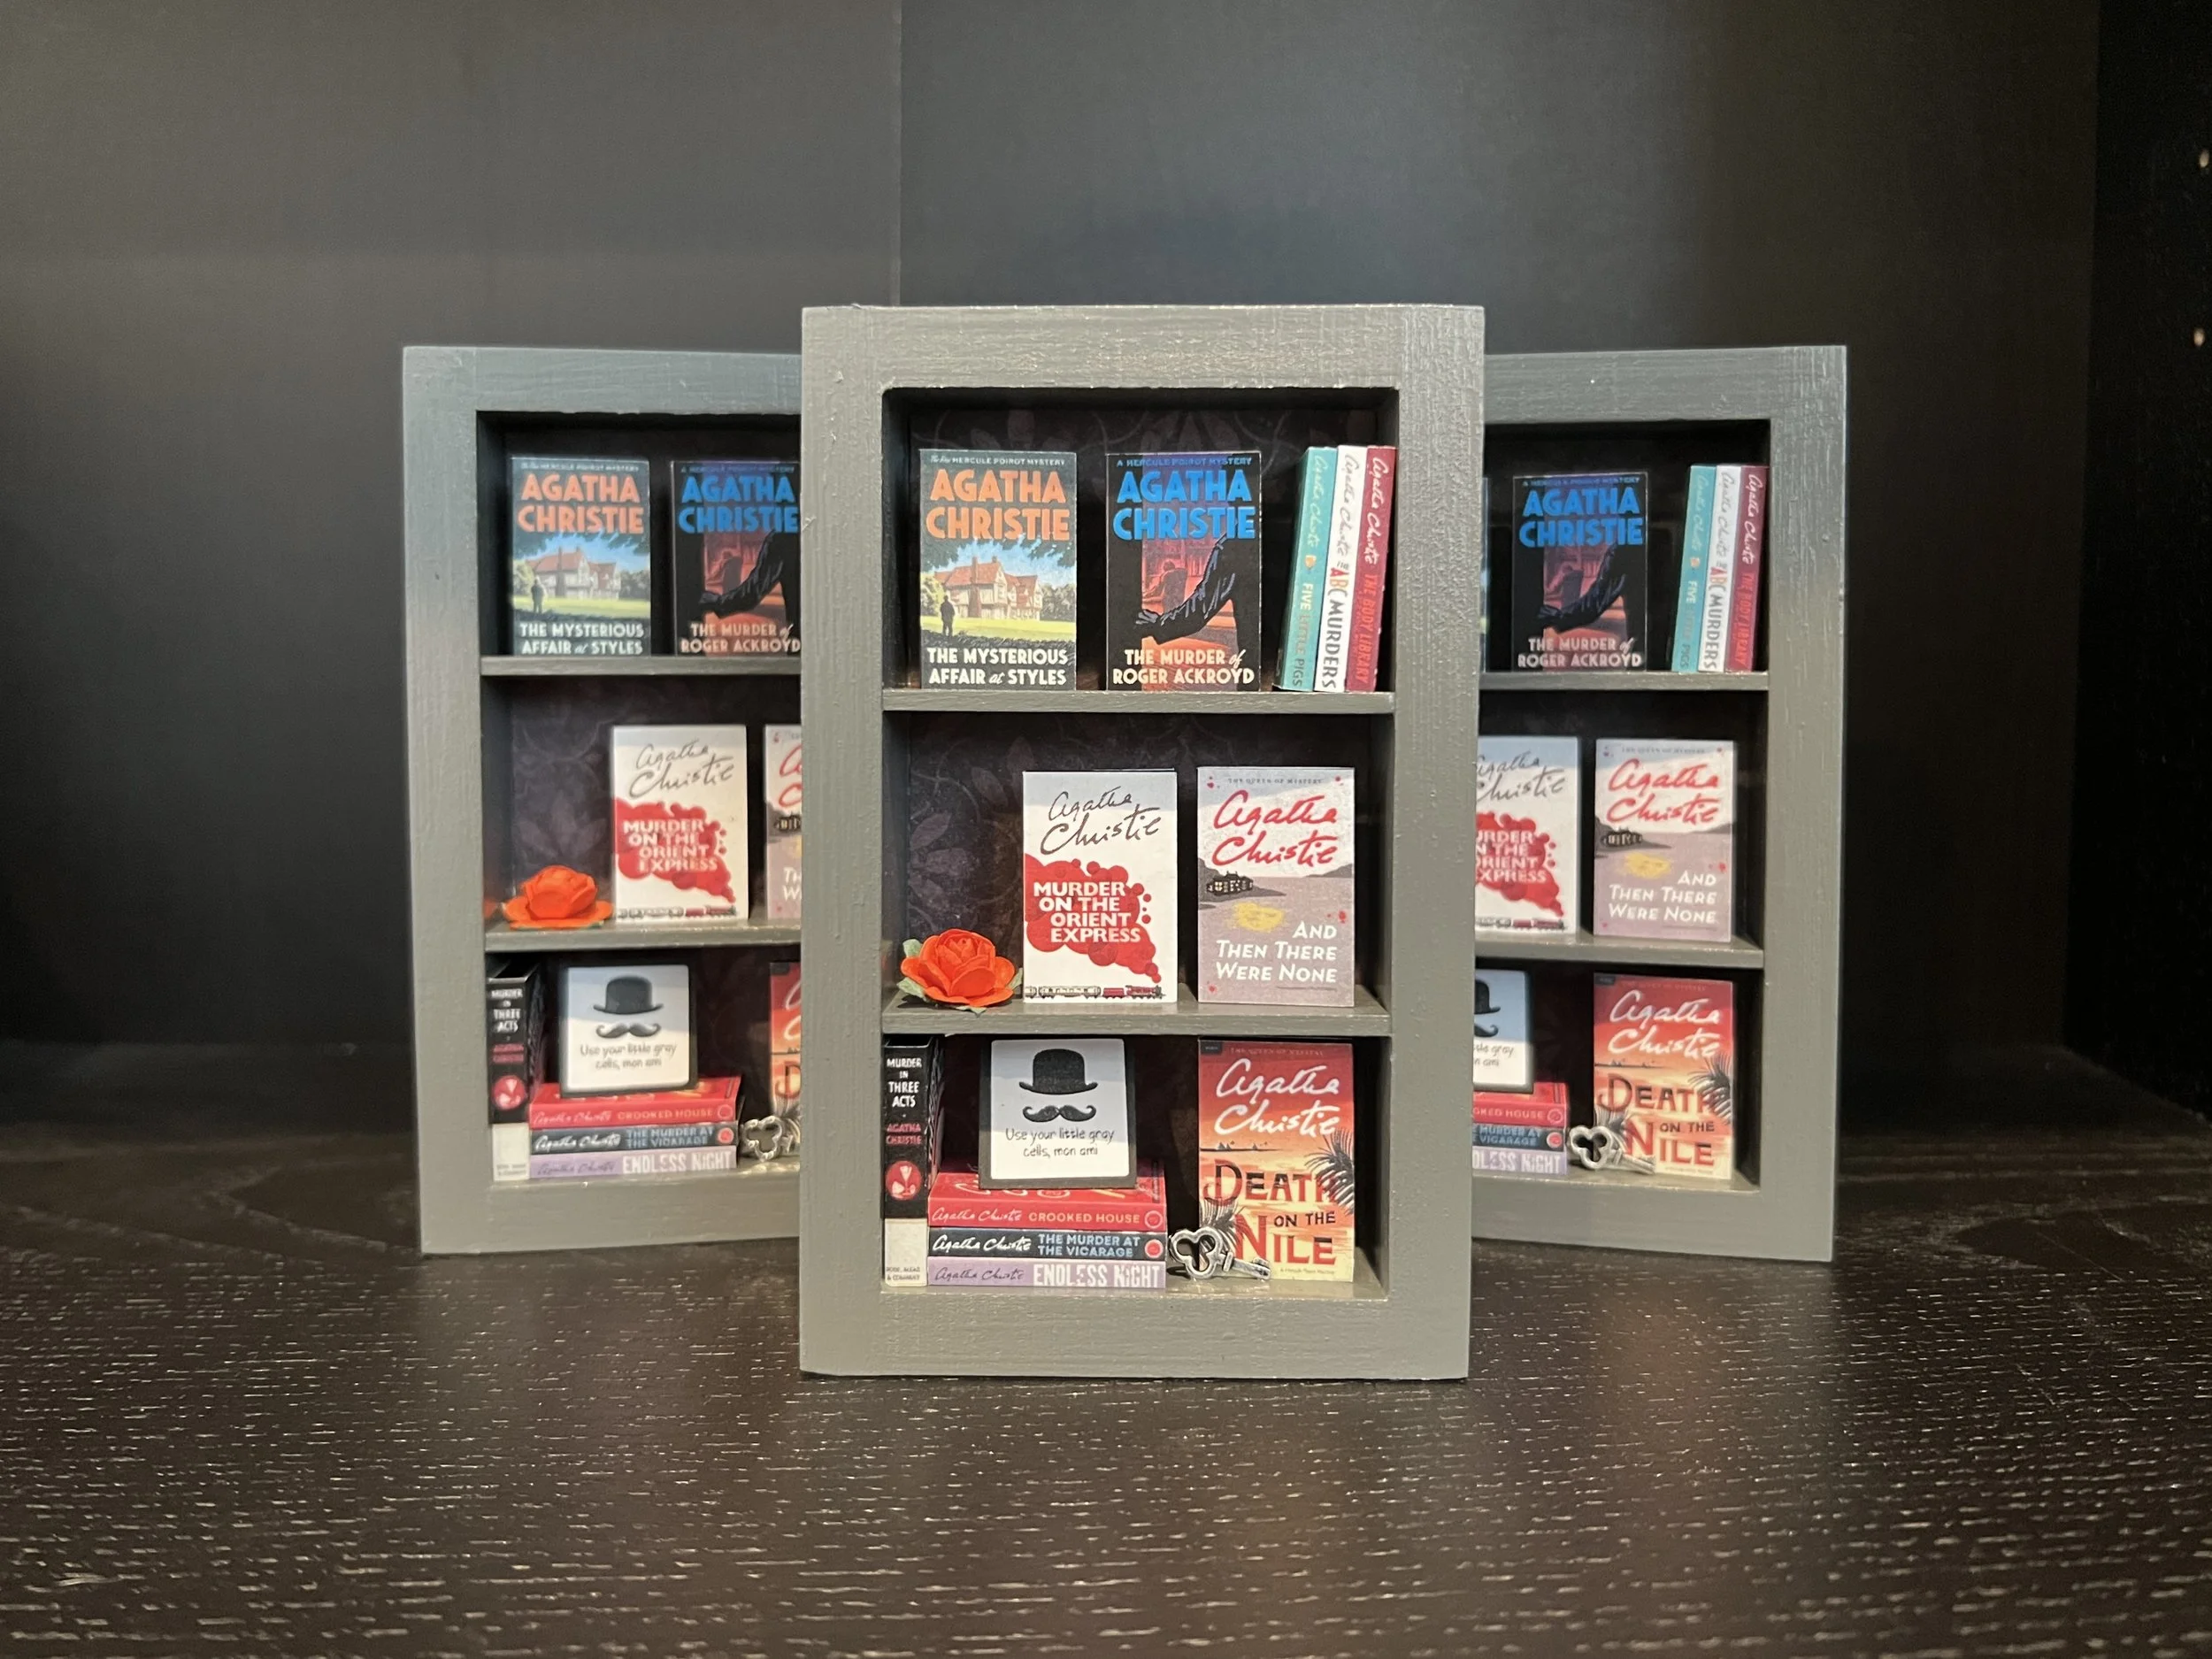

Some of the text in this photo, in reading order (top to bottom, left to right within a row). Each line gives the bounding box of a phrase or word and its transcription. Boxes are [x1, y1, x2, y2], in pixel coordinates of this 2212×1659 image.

[1027, 457, 1065, 466] MYSTERY
[521, 472, 641, 503] AGATHA
[681, 476, 795, 503] AGATHA
[930, 468, 1066, 503] AGATHA
[1117, 469, 1252, 503] AGATHA
[1369, 457, 1389, 509] Agatha
[1523, 487, 1640, 517] AGATHA
[518, 505, 644, 534] CHRISTIE
[679, 506, 799, 533] CHRISTIE
[926, 506, 1070, 541] CHRISTIE
[1112, 506, 1256, 541] CHRISTIE
[1363, 512, 1382, 565] Christie
[1519, 518, 1643, 548] CHRISTIE
[1327, 567, 1349, 597] ABC
[520, 622, 644, 639] THE MYSTERIOUS
[690, 623, 777, 637] THE MURDER
[1293, 582, 1314, 687] FIVE PIGS
[1703, 594, 1724, 669] MURDERS
[522, 640, 642, 655] AFFAIR at STYLES
[680, 638, 801, 653] ROGER ACKROYD
[1321, 599, 1346, 688] MURDERS
[1528, 637, 1554, 651] THE
[1559, 637, 1616, 651] MURDER
[927, 648, 1069, 665] THE MYSTERIOUS
[1125, 649, 1247, 669] THE MURDER of
[1517, 653, 1642, 667] ROGER ACKROYD
[929, 668, 1067, 685] AFFAIR at STYLES
[1113, 667, 1255, 685] ROGER ACKROYD
[635, 738, 708, 771] Agatha
[629, 754, 734, 798] Christie
[1608, 758, 1719, 796] Agatha
[1048, 786, 1133, 822] Agatha
[1213, 789, 1338, 835] Agatha
[1607, 794, 1720, 825] Christie
[623, 818, 704, 833] MURDER
[1040, 804, 1162, 856] Christie
[628, 832, 700, 847] ON THE
[1212, 830, 1338, 867] Christie
[1492, 842, 1529, 856] THE
[638, 845, 710, 859] ORIENT
[638, 858, 718, 872] EXPRESS
[1678, 871, 1717, 885] AND
[1033, 881, 1126, 897] MURDER
[1609, 884, 1717, 904] THEN THERE
[1039, 897, 1120, 912] ON THE
[1609, 903, 1718, 924] WERE NONE
[1050, 912, 1132, 927] ORIENT
[1050, 928, 1141, 943] EXPRESS
[1292, 920, 1338, 940] AND
[1216, 940, 1338, 961] THEN THERE
[1216, 962, 1338, 983] WERE NONE
[1609, 989, 1722, 1029] Agatha
[496, 1020, 518, 1033] ACTS
[580, 1044, 601, 1056] Use
[603, 1046, 625, 1057] your
[1607, 1025, 1721, 1059] Christie
[887, 1058, 922, 1068] MURDER
[888, 1081, 920, 1094] THREE
[1216, 1057, 1340, 1105] Agatha
[892, 1095, 916, 1108] ACTS
[1597, 1072, 1717, 1113] DEATH
[617, 1111, 672, 1121] CROOKED
[677, 1109, 713, 1118] HOUSE
[1214, 1099, 1340, 1138] Christie
[1506, 1110, 1544, 1119] HOUSE
[626, 1128, 648, 1139] THE
[651, 1127, 696, 1137] MURDER
[699, 1126, 714, 1135] AT
[887, 1124, 921, 1133] AGATHA
[1005, 1127, 1116, 1146] Use your little gray
[1479, 1125, 1525, 1137] MURDER
[1527, 1128, 1543, 1138] AT
[1659, 1122, 1715, 1133] ON THE
[626, 1136, 708, 1148] THE VICARAGE
[1023, 1145, 1098, 1158] cells, mon ami
[1624, 1118, 1715, 1166] NILE
[622, 1151, 733, 1174] ENDLESS NIGHT
[1521, 1154, 1562, 1174] NIGHT
[1202, 1159, 1337, 1207] DEATH
[932, 1207, 1141, 1224] Agatha Christie CROOKED HOUSE
[1273, 1210, 1337, 1227] ON THE
[933, 1233, 1141, 1252] Agatha Christie THE MURDER AT
[1234, 1211, 1337, 1266] NILE
[1037, 1245, 1134, 1257] THE VICARAGE
[934, 1263, 1160, 1287] Agatha Christie ENDLESS NIGHT
